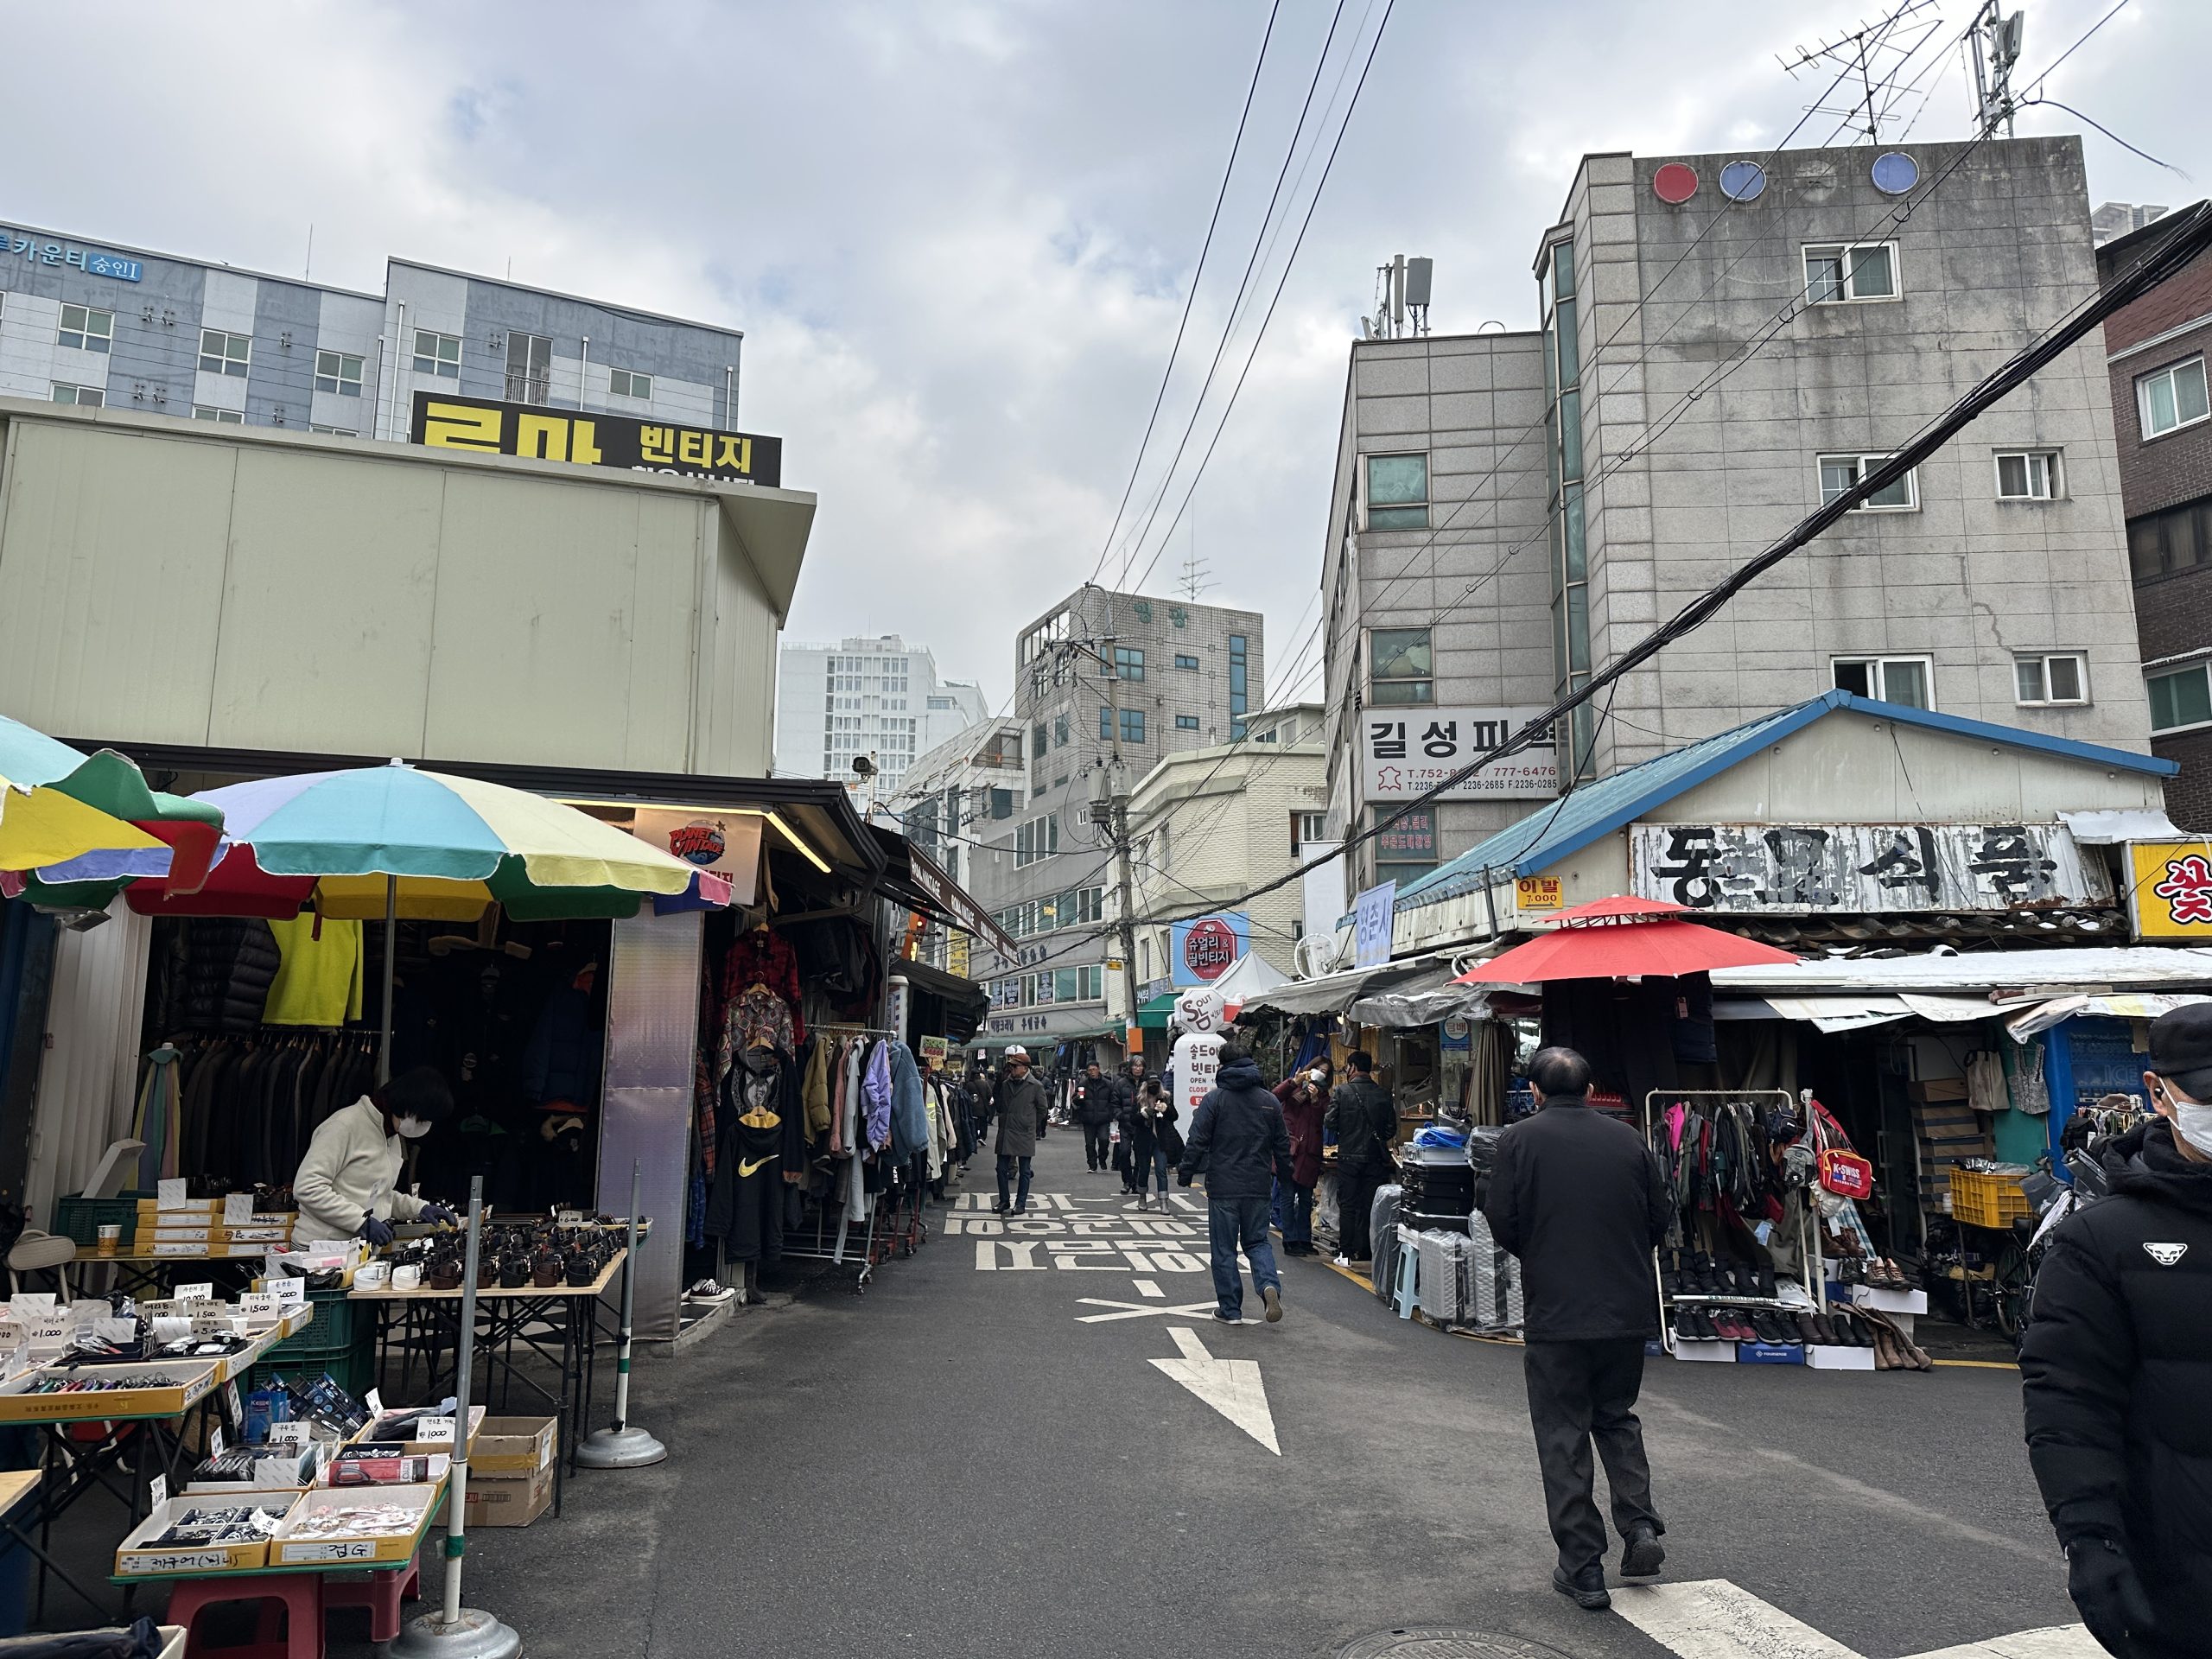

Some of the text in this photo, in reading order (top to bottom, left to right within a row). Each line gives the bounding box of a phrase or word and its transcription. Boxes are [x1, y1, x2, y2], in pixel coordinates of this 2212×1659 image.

[640, 424, 753, 474] 빈티지
[1494, 766, 1556, 777] 777-6476
[1463, 780, 1504, 790] 2236-2685
[1508, 779, 1557, 790] F.2236-0285
[670, 827, 713, 842] PLANET
[1519, 880, 1559, 893] 이발
[1188, 936, 1230, 950] 쥬얼리 &
[1188, 951, 1230, 967] 필빈티지
